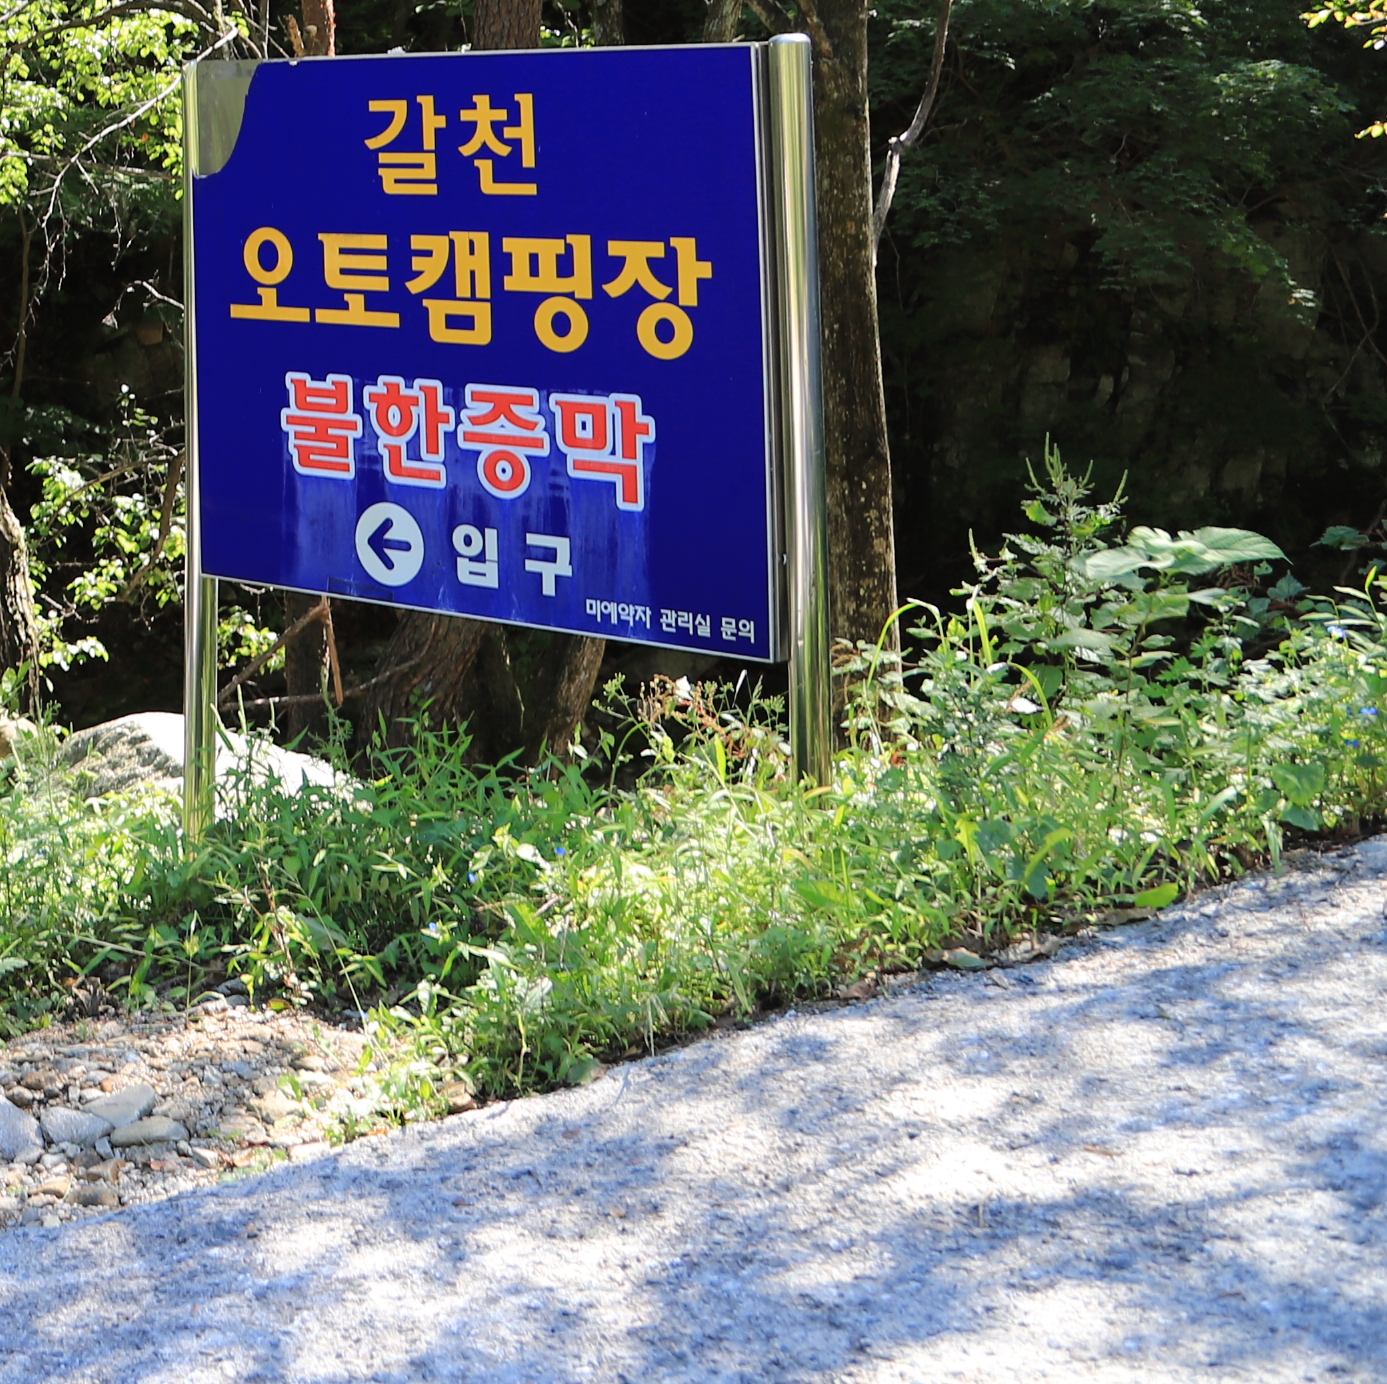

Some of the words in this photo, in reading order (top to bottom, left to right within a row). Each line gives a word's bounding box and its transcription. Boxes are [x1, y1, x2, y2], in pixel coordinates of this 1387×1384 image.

[364, 93, 538, 195] 갈천
[230, 226, 712, 359] 오토캠핑장
[281, 371, 656, 511] 불한증막
[452, 524, 573, 597] 입구
[659, 608, 711, 638] 관리실
[720, 616, 755, 644] 문의
